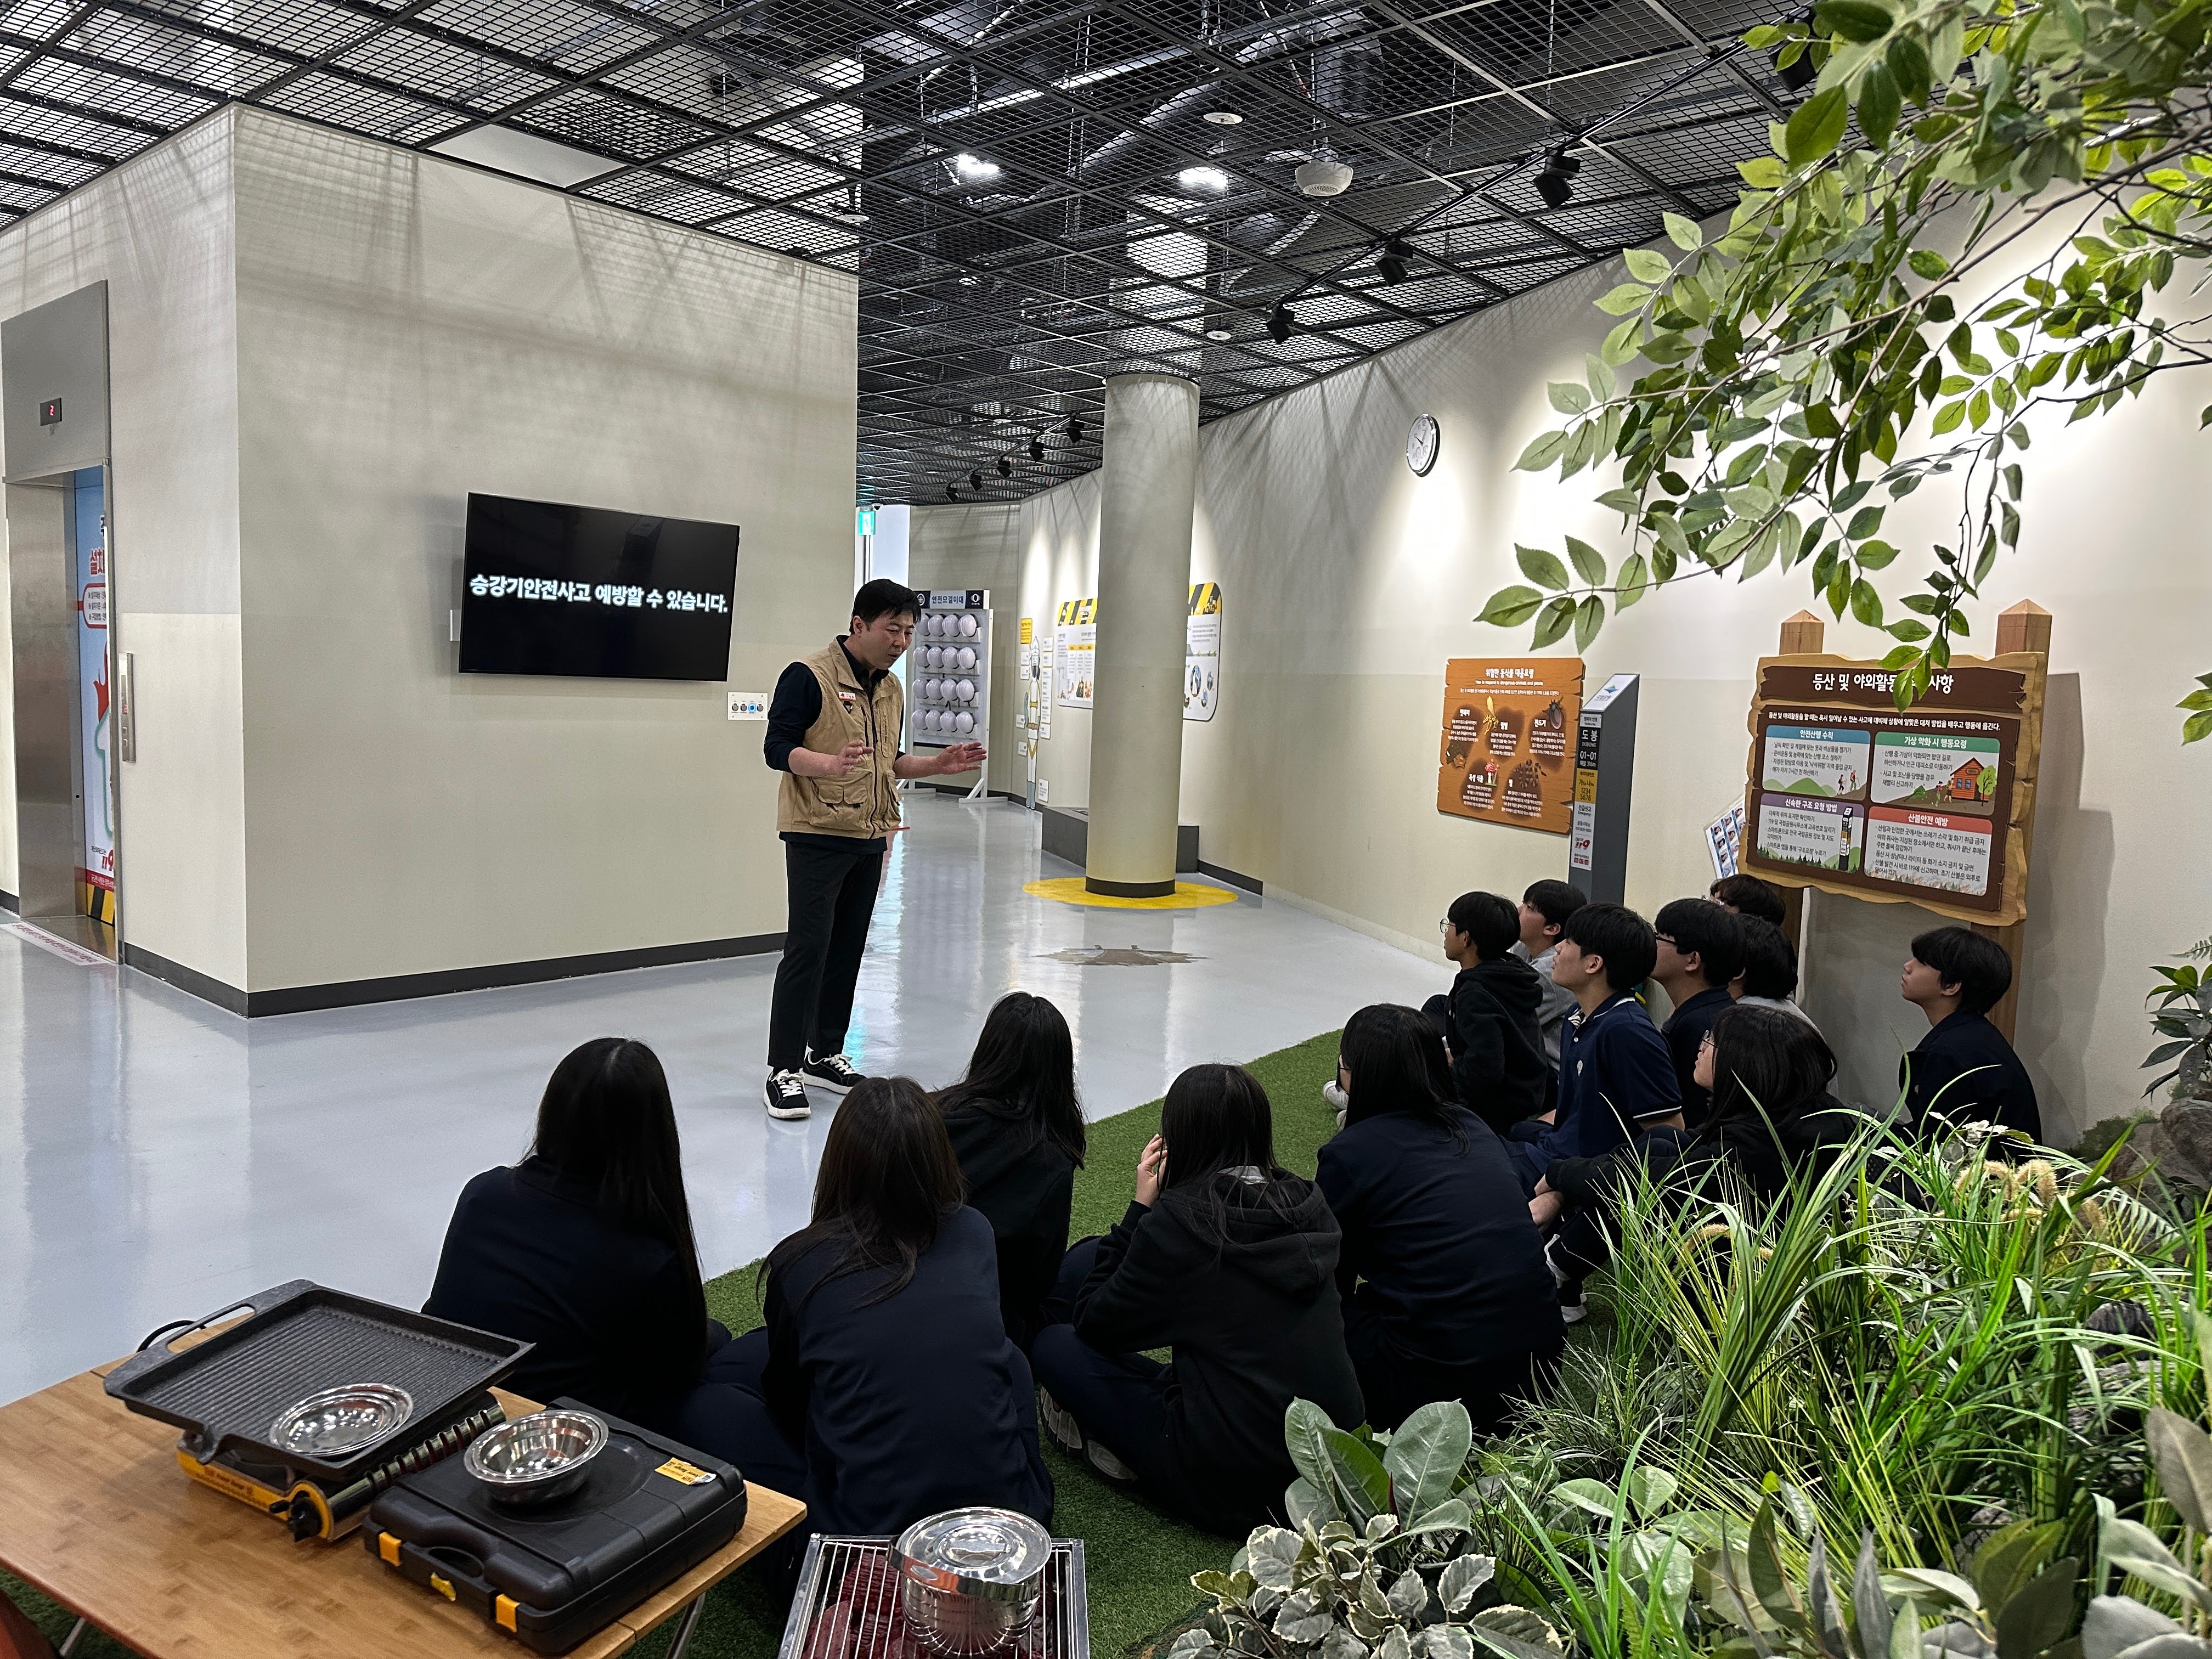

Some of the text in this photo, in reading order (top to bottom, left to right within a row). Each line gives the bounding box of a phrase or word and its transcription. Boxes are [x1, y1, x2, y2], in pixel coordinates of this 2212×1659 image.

[50, 405, 54, 416] 2
[470, 574, 729, 613] 승강기안전사고 예방할 수 있습니다.
[932, 596, 964, 604] 안전모걸이대
[1813, 673, 1835, 690] 등산
[1838, 674, 1849, 691] 및
[1582, 730, 1598, 742] 도봉
[1799, 729, 1833, 740] 안전산행 수칙
[1904, 736, 1967, 749] 기상 악화 시 행동요령
[1580, 751, 1596, 760] 01-01
[1785, 798, 1837, 812] 신속한 구조 요청 방법
[1908, 813, 1948, 827] 산불안전 예방
[1575, 840, 1590, 850] 119
